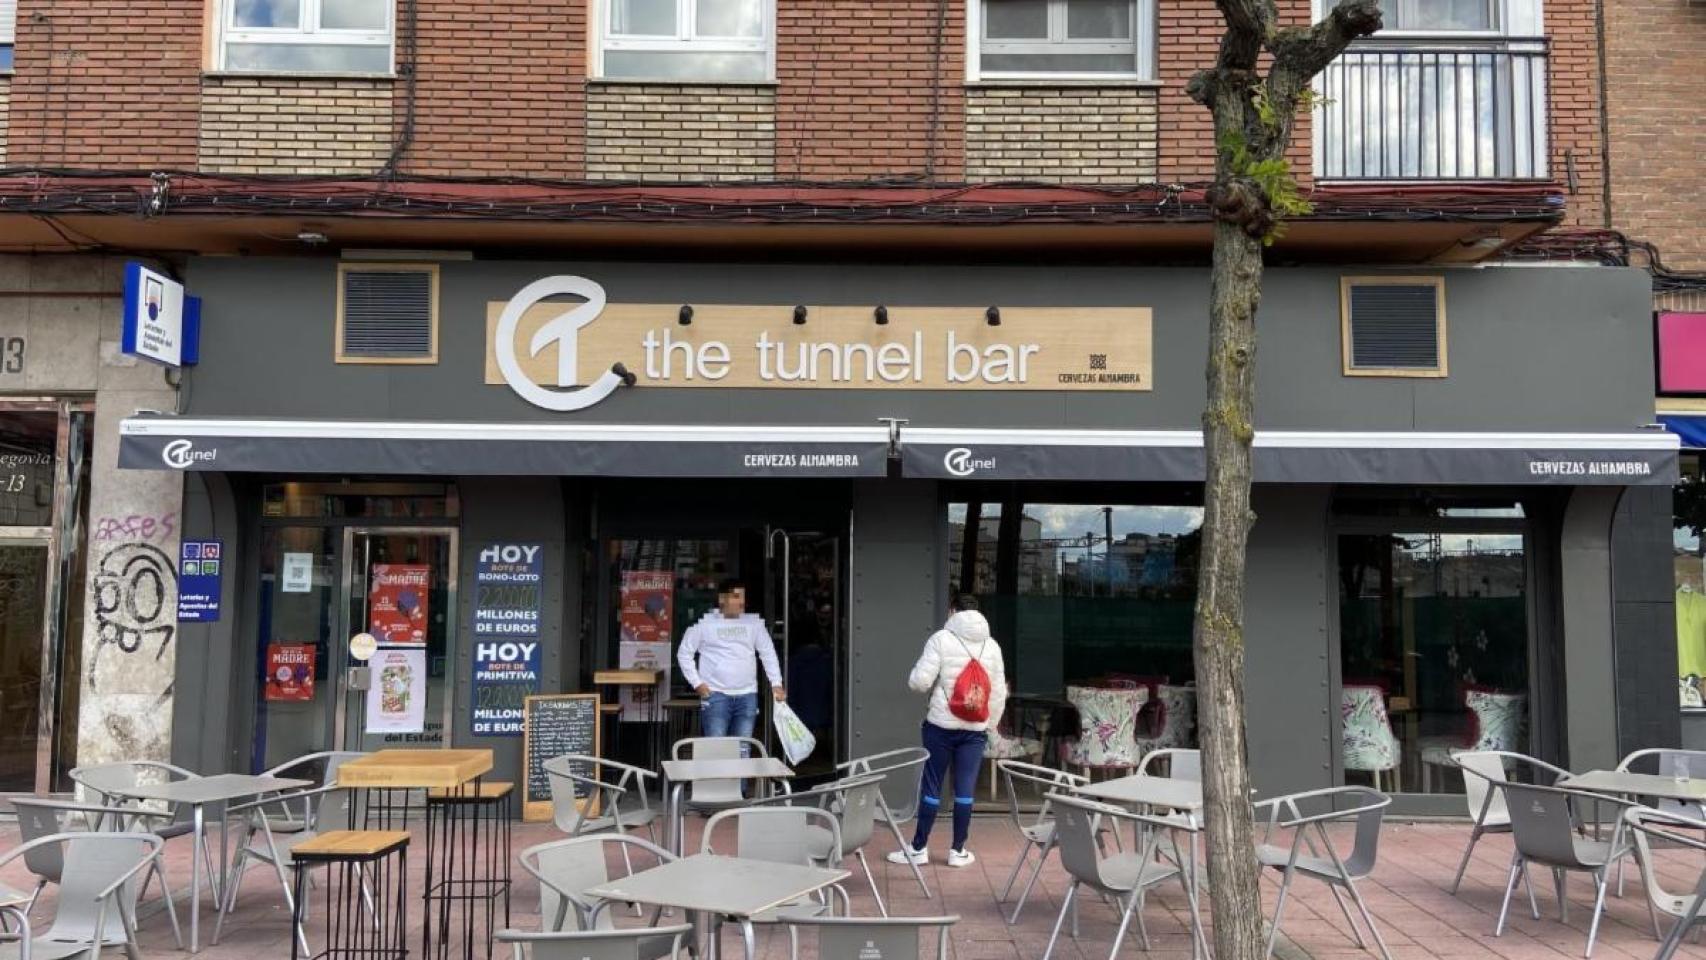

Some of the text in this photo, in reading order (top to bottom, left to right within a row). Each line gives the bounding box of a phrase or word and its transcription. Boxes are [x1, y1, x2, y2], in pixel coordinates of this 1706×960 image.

[642, 327, 1040, 383] the tunnel bar
[1058, 373, 1141, 384] CERVEZAS ALHAMBRA
[744, 454, 859, 467] CERVEZAS ALHAMBRA
[1530, 461, 1650, 475] CERVEZAS ALHAMBRA
[480, 545, 540, 564] HOY
[478, 572, 540, 581] BONO-LOTO
[477, 609, 537, 620] MILLONES
[476, 622, 537, 633] DE EUROS
[477, 642, 537, 662] HOY
[273, 653, 310, 664] MADRE
[489, 663, 525, 671] BOTE DE
[477, 671, 536, 680] PRIMITIVA
[474, 723, 490, 732] DE
[385, 733, 402, 742] del
